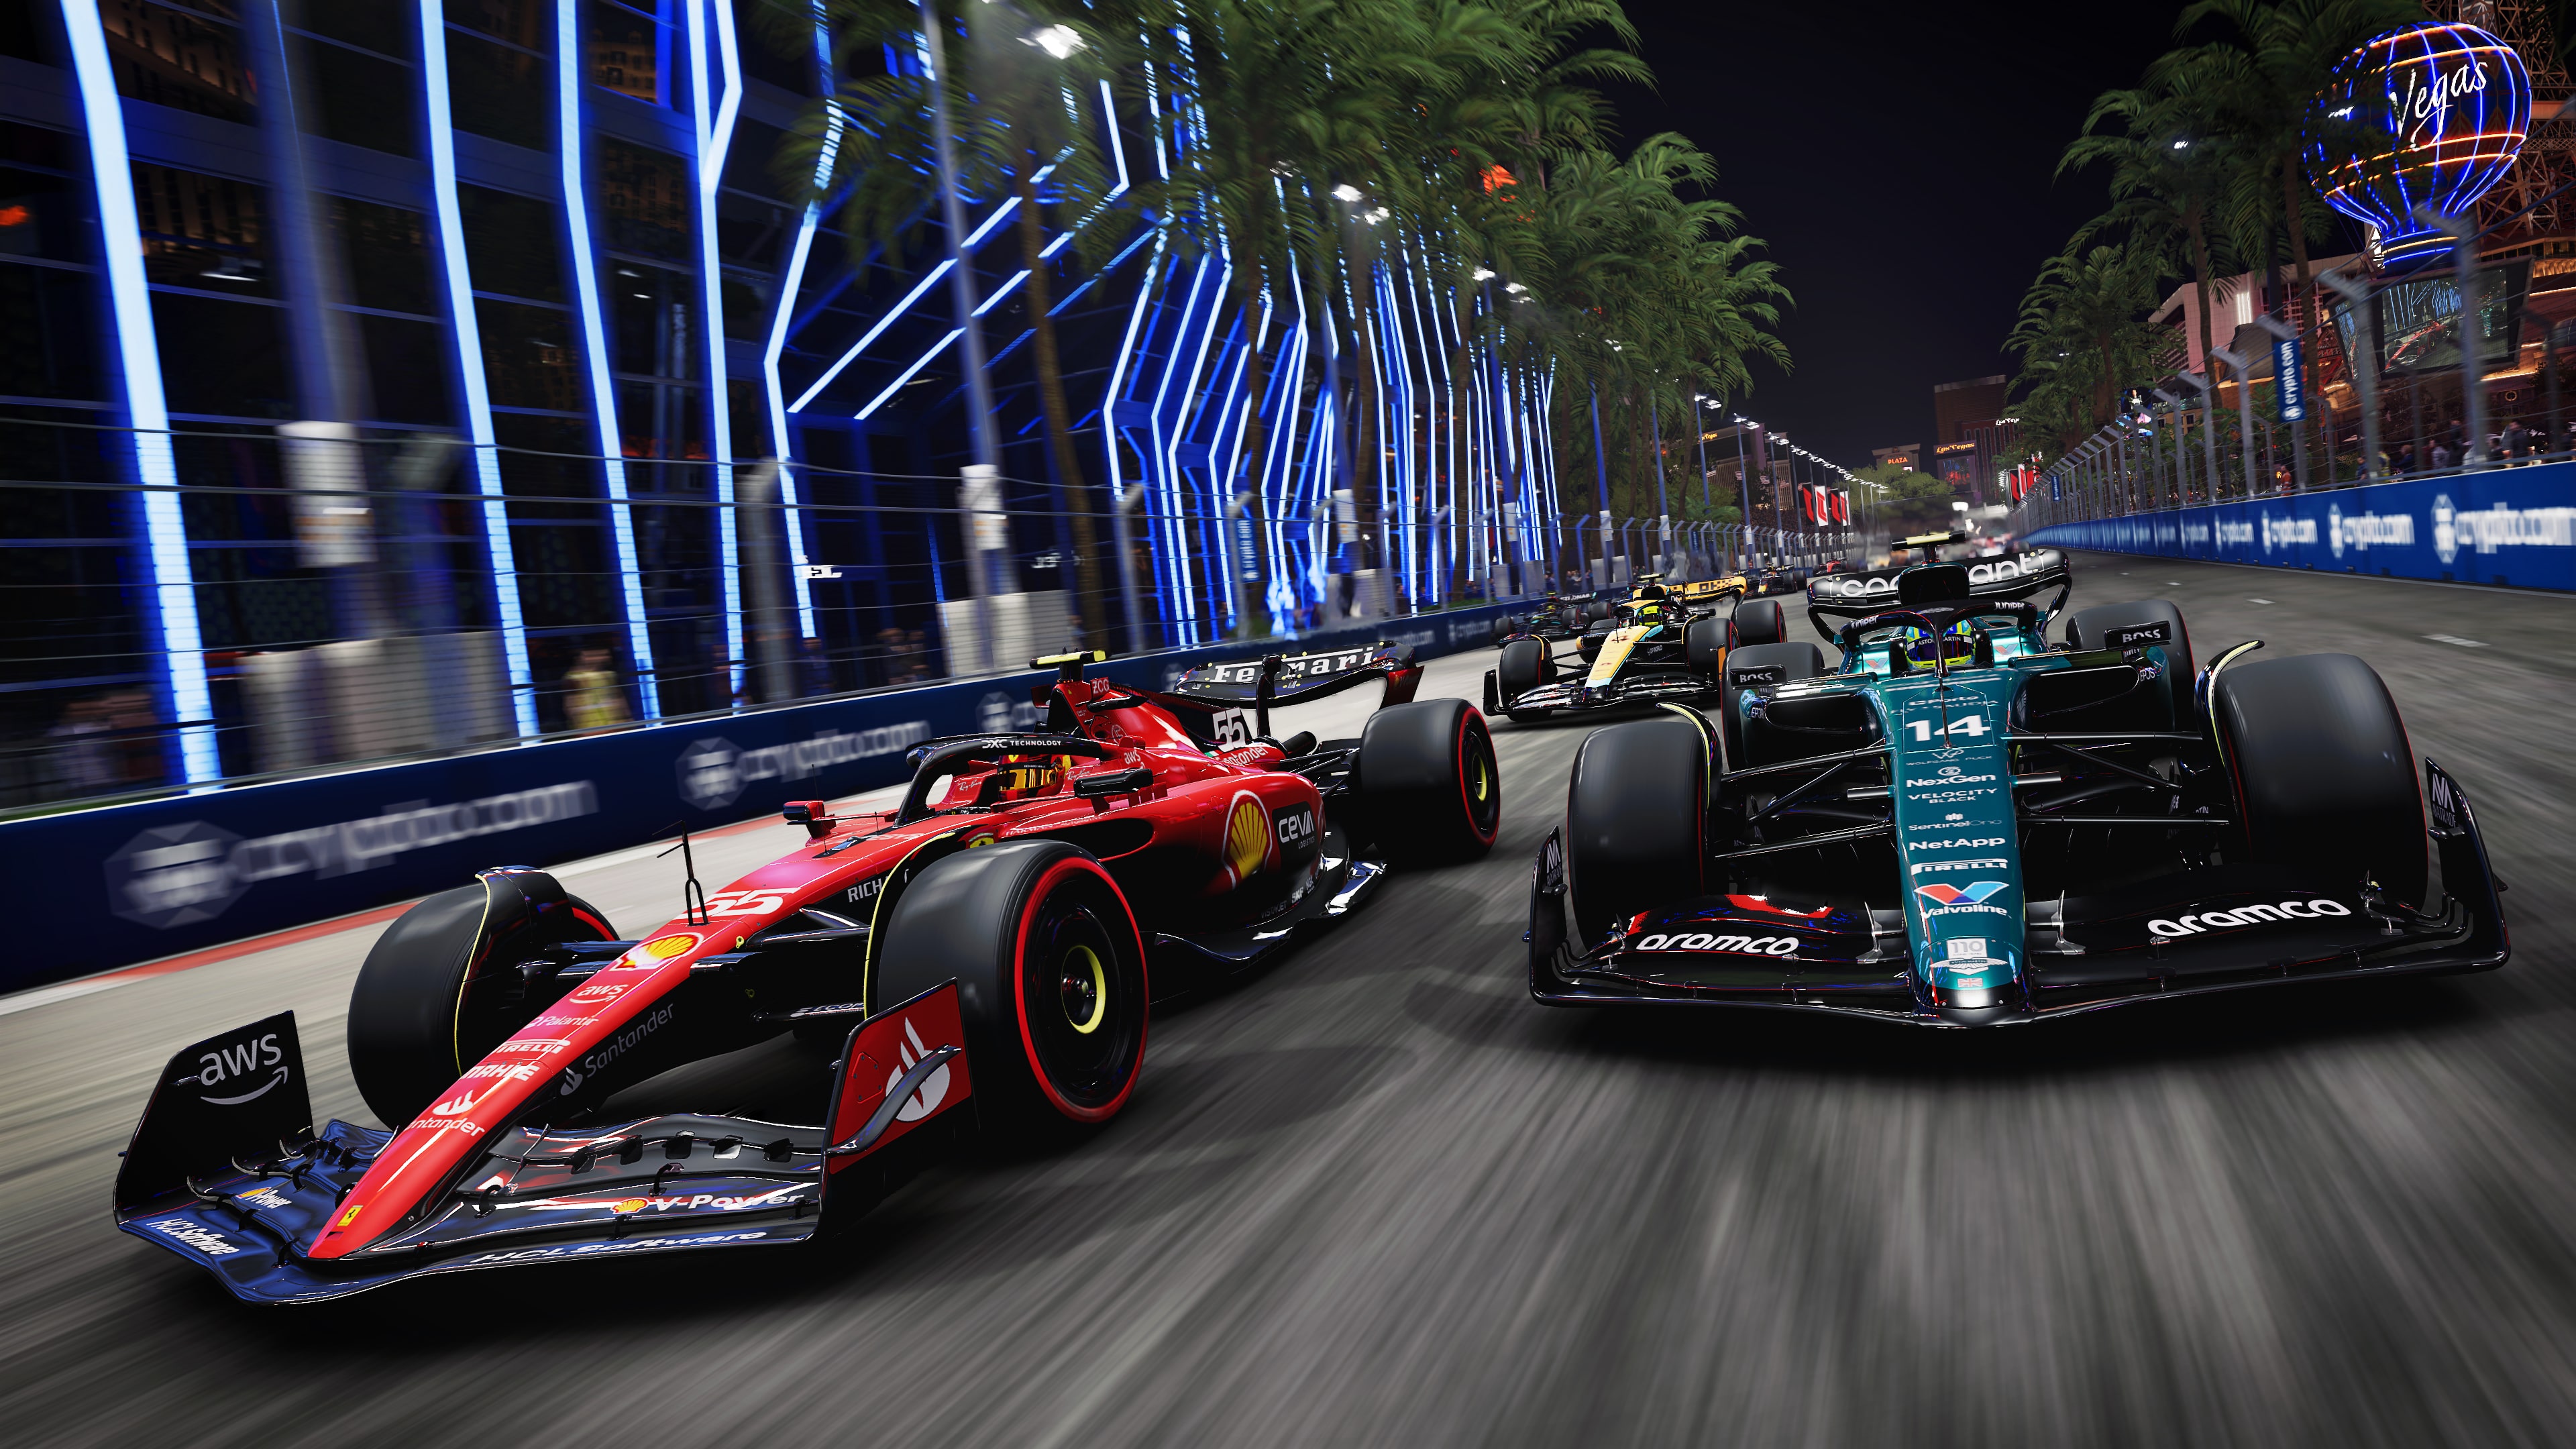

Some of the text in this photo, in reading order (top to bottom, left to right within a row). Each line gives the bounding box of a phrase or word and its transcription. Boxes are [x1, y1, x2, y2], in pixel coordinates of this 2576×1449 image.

[2389, 62, 2488, 152] Vegas
[2281, 341, 2299, 405] crypto.com
[1950, 442, 1976, 451] Vegas
[1888, 456, 1908, 465] PLAZA
[1918, 637, 1934, 647] ASTO
[2123, 629, 2161, 643] BOSS
[1210, 647, 1375, 684] Ferari
[1740, 673, 1773, 683] BOSS
[1212, 706, 1246, 753] 55
[1905, 715, 1991, 742] 14
[1124, 749, 1141, 765] aws
[1905, 758, 1960, 766] WOLFGANG
[1906, 774, 1996, 788] NexGen
[1908, 788, 1998, 800] VELOCITY
[1929, 796, 1976, 804] BLACK
[1909, 818, 2002, 830] SentinelOne
[1298, 835, 1316, 849] LOGISTICS
[1909, 837, 2006, 851] NetApp
[1911, 858, 2008, 875] PIRELLI
[1291, 886, 1304, 904] SKF
[674, 887, 801, 920] 55
[1923, 903, 2008, 920] Valvoline
[2147, 899, 2352, 938] aramco
[1635, 933, 1799, 955] aramco
[1950, 941, 1984, 953] 110
[577, 984, 629, 997] aws
[542, 1015, 600, 1028] Palantir
[584, 1004, 674, 1078] Santander
[199, 1034, 282, 1086] aws
[404, 1117, 485, 1137] antander
[655, 1193, 804, 1212] V-Power
